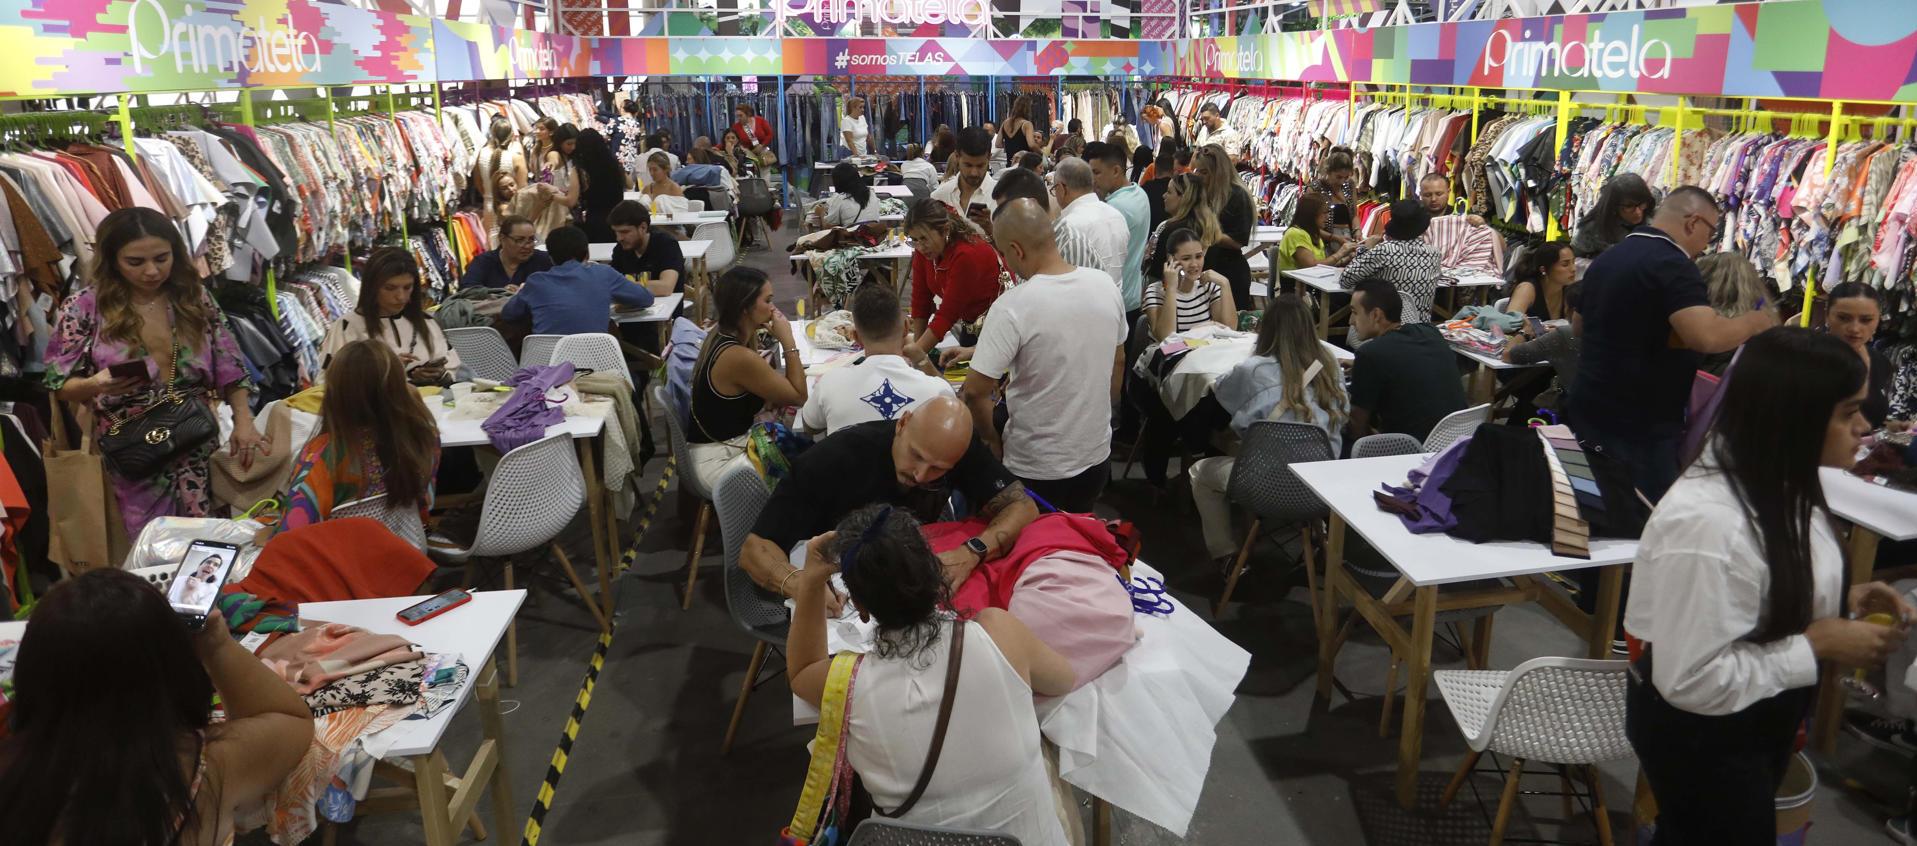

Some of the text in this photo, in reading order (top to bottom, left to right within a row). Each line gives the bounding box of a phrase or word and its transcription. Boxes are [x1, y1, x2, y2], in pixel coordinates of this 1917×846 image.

[128, 0, 321, 74] Primatela
[508, 36, 557, 71] Primatela
[1483, 24, 1672, 80] Primatela
[834, 48, 944, 70] #somosTELAS
[1205, 42, 1263, 72] Primatela
